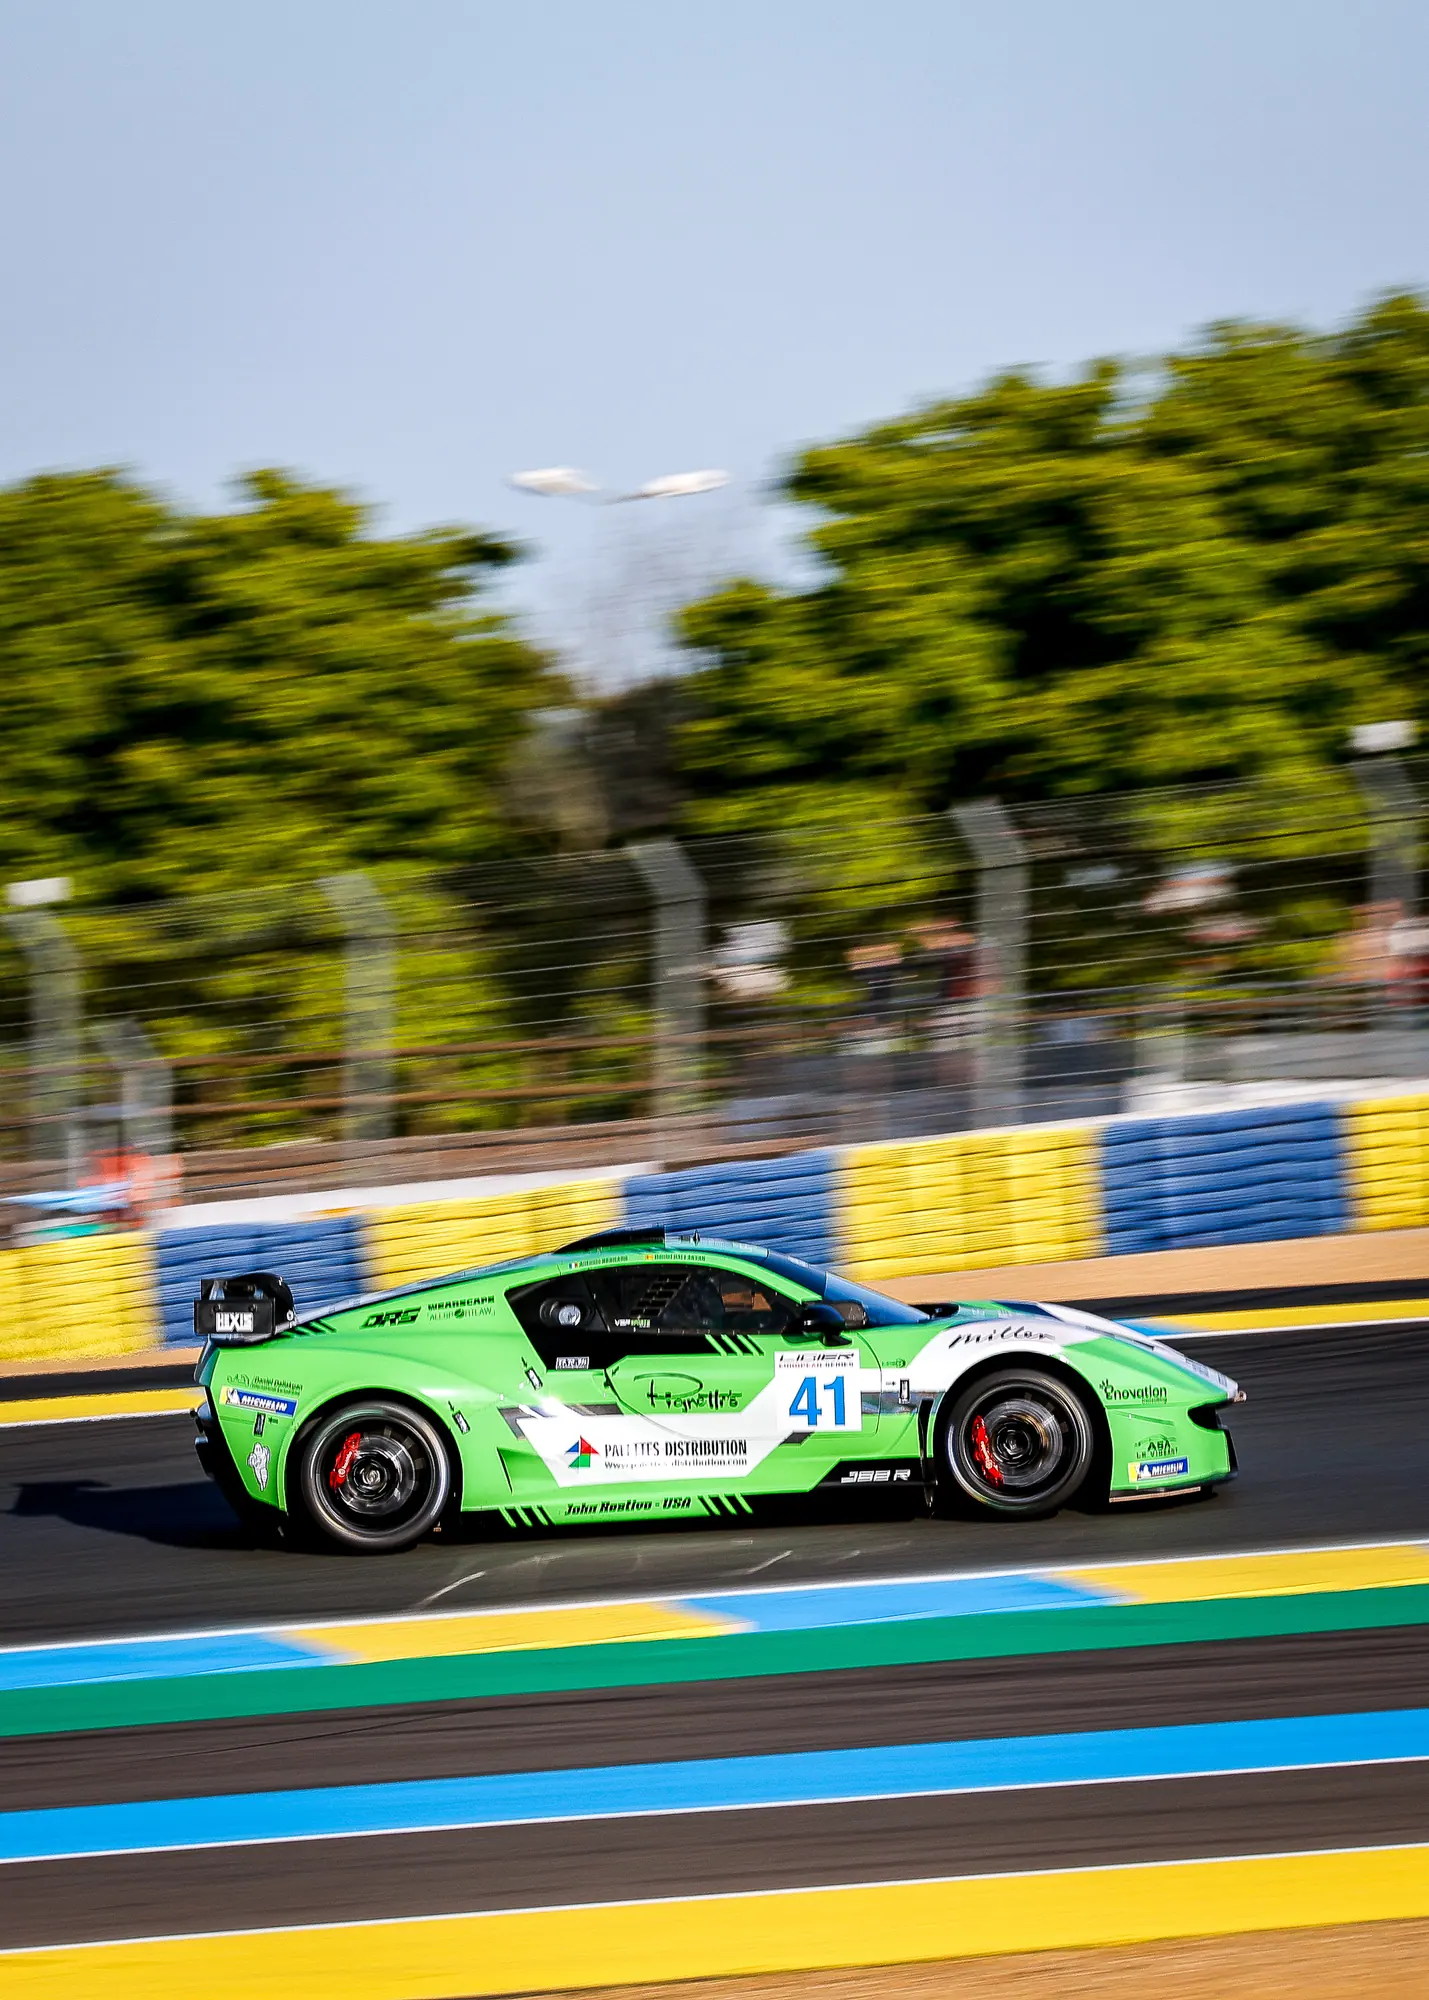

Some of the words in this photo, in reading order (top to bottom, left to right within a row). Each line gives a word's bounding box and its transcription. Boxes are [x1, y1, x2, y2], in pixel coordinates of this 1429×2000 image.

[241, 1395, 288, 1411] MICHELIN
[789, 1376, 845, 1426] 41
[664, 1439, 748, 1456] DISTRIBUTION
[893, 1469, 911, 1481] R
[1151, 1462, 1184, 1476] MICHELIN
[564, 1503, 597, 1516] John
[663, 1496, 692, 1509] USA
